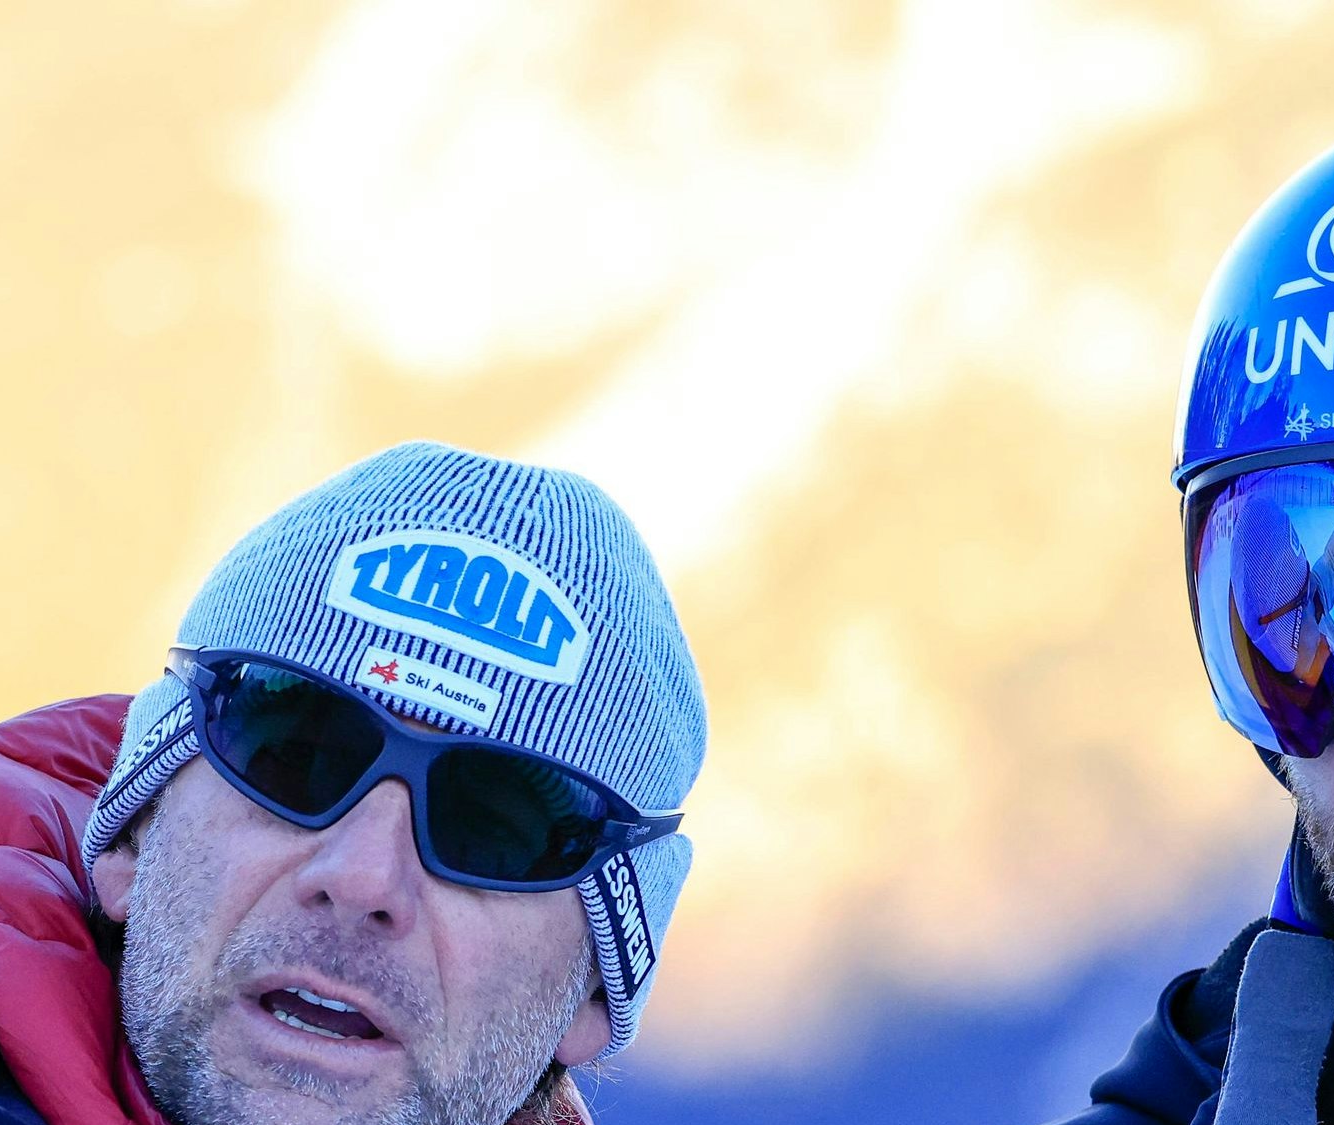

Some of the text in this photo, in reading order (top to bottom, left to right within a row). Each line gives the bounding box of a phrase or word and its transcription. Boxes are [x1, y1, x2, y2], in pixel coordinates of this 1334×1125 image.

[350, 544, 577, 667] TYROLIT
[405, 673, 487, 713] Ski Austria
[601, 852, 652, 986] ESSWEIN
